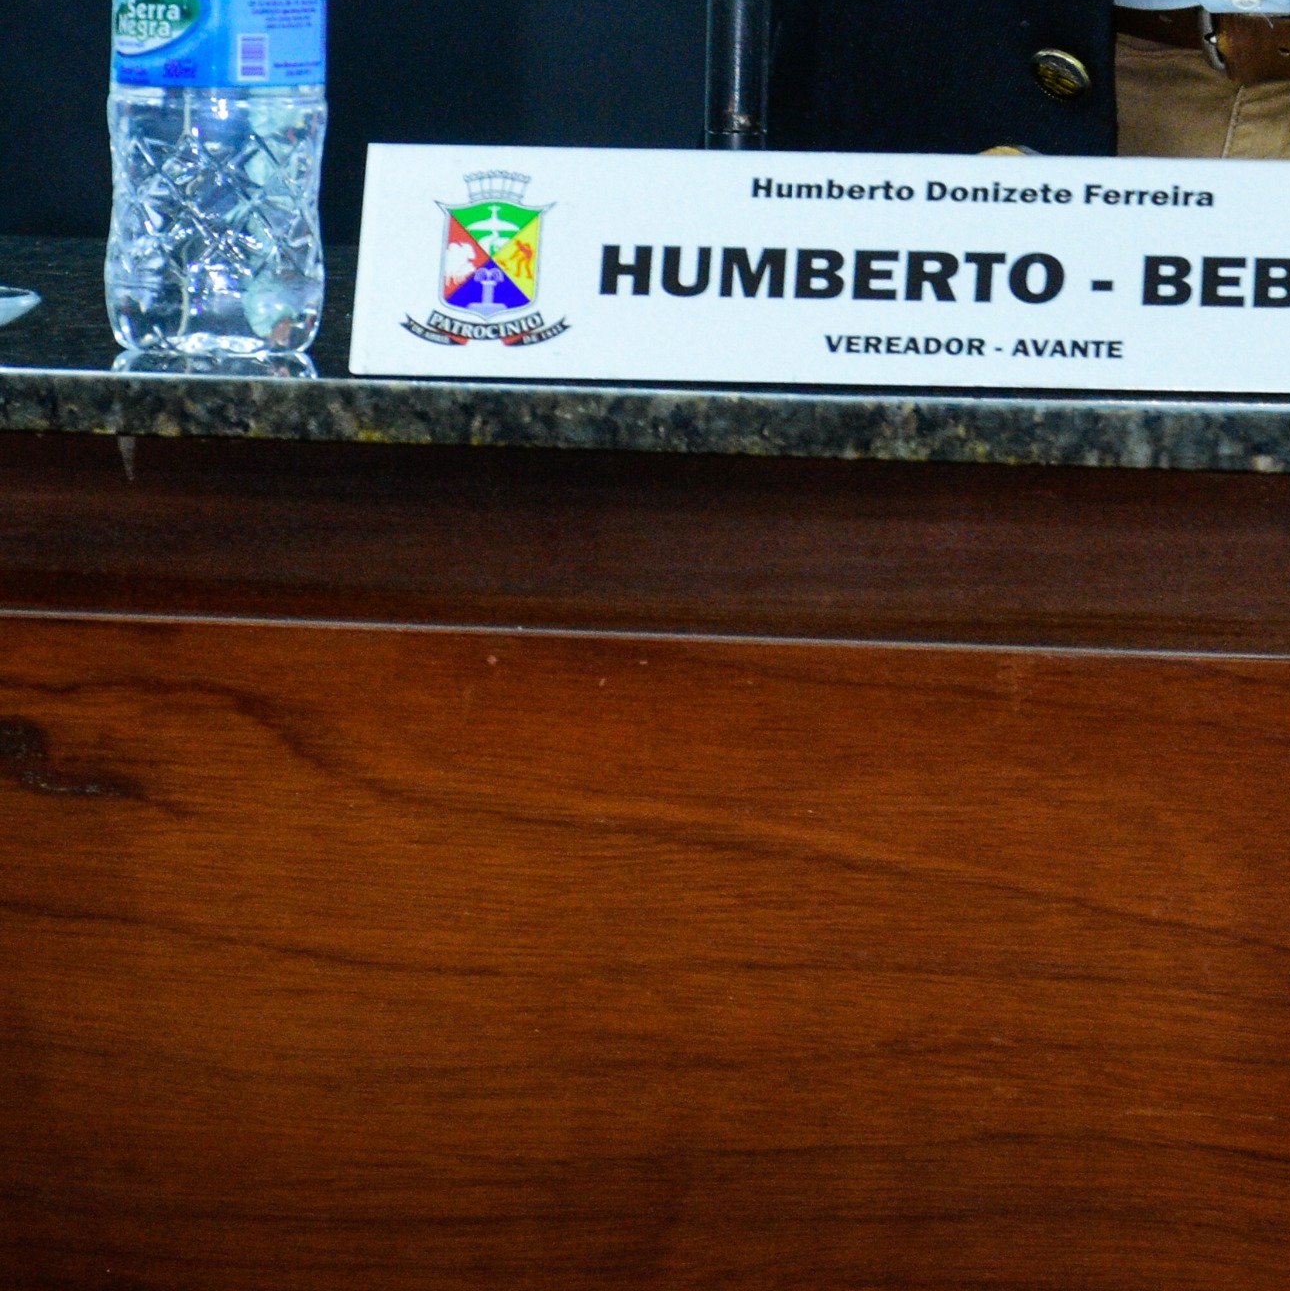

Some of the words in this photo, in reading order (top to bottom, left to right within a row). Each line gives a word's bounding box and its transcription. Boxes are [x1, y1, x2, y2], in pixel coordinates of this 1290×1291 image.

[118, 13, 171, 40] Negra
[752, 177, 915, 201] Humberto
[926, 181, 1073, 204] Donizete
[1084, 184, 1214, 207] Ferreira
[599, 244, 1065, 305] HUMBERTO
[1091, 279, 1114, 292] -
[825, 335, 986, 356] VEREADOR
[1012, 339, 1123, 359] AVANTE
